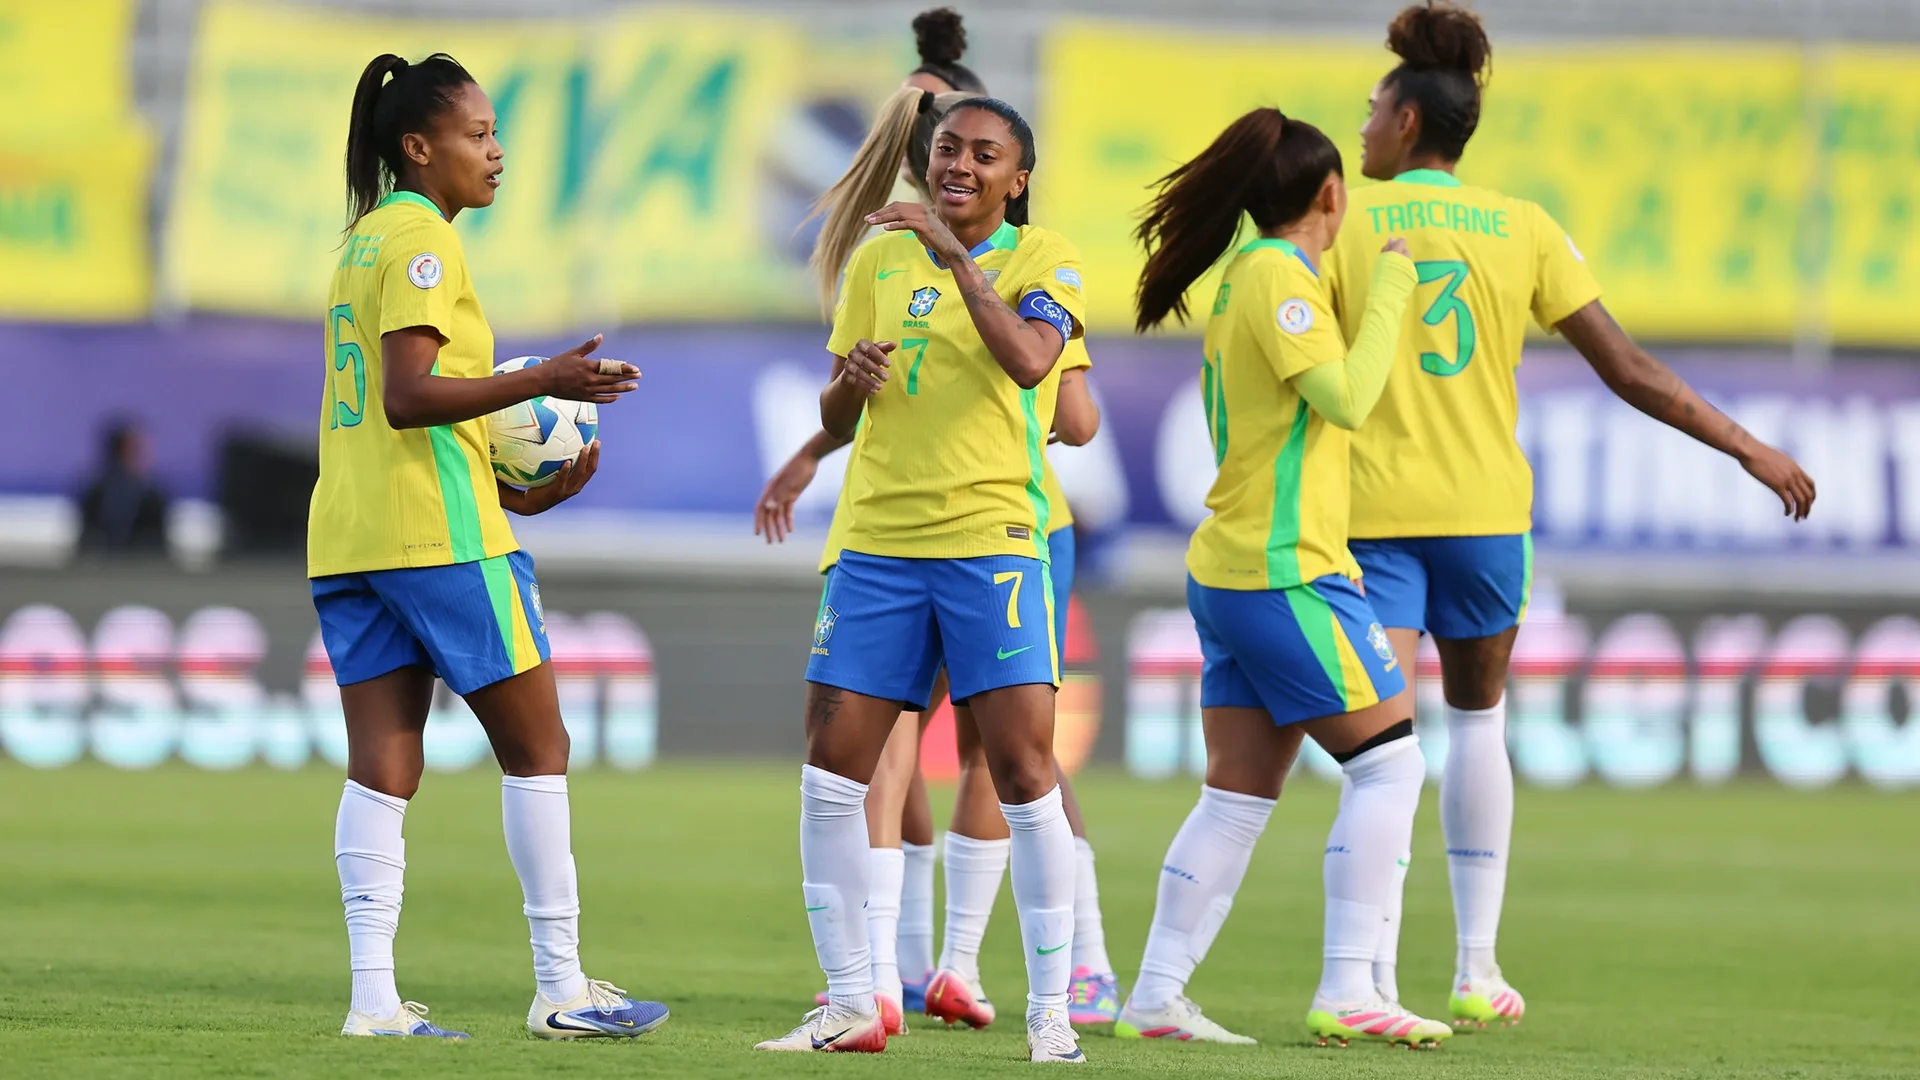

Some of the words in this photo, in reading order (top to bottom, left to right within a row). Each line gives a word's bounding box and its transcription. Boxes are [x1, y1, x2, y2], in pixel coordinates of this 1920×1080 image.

[1366, 200, 1509, 239] TARCIANE
[902, 320, 930, 329] BRASIL
[1414, 260, 1476, 377] 3
[902, 338, 929, 396] 7
[993, 571, 1023, 629] 7
